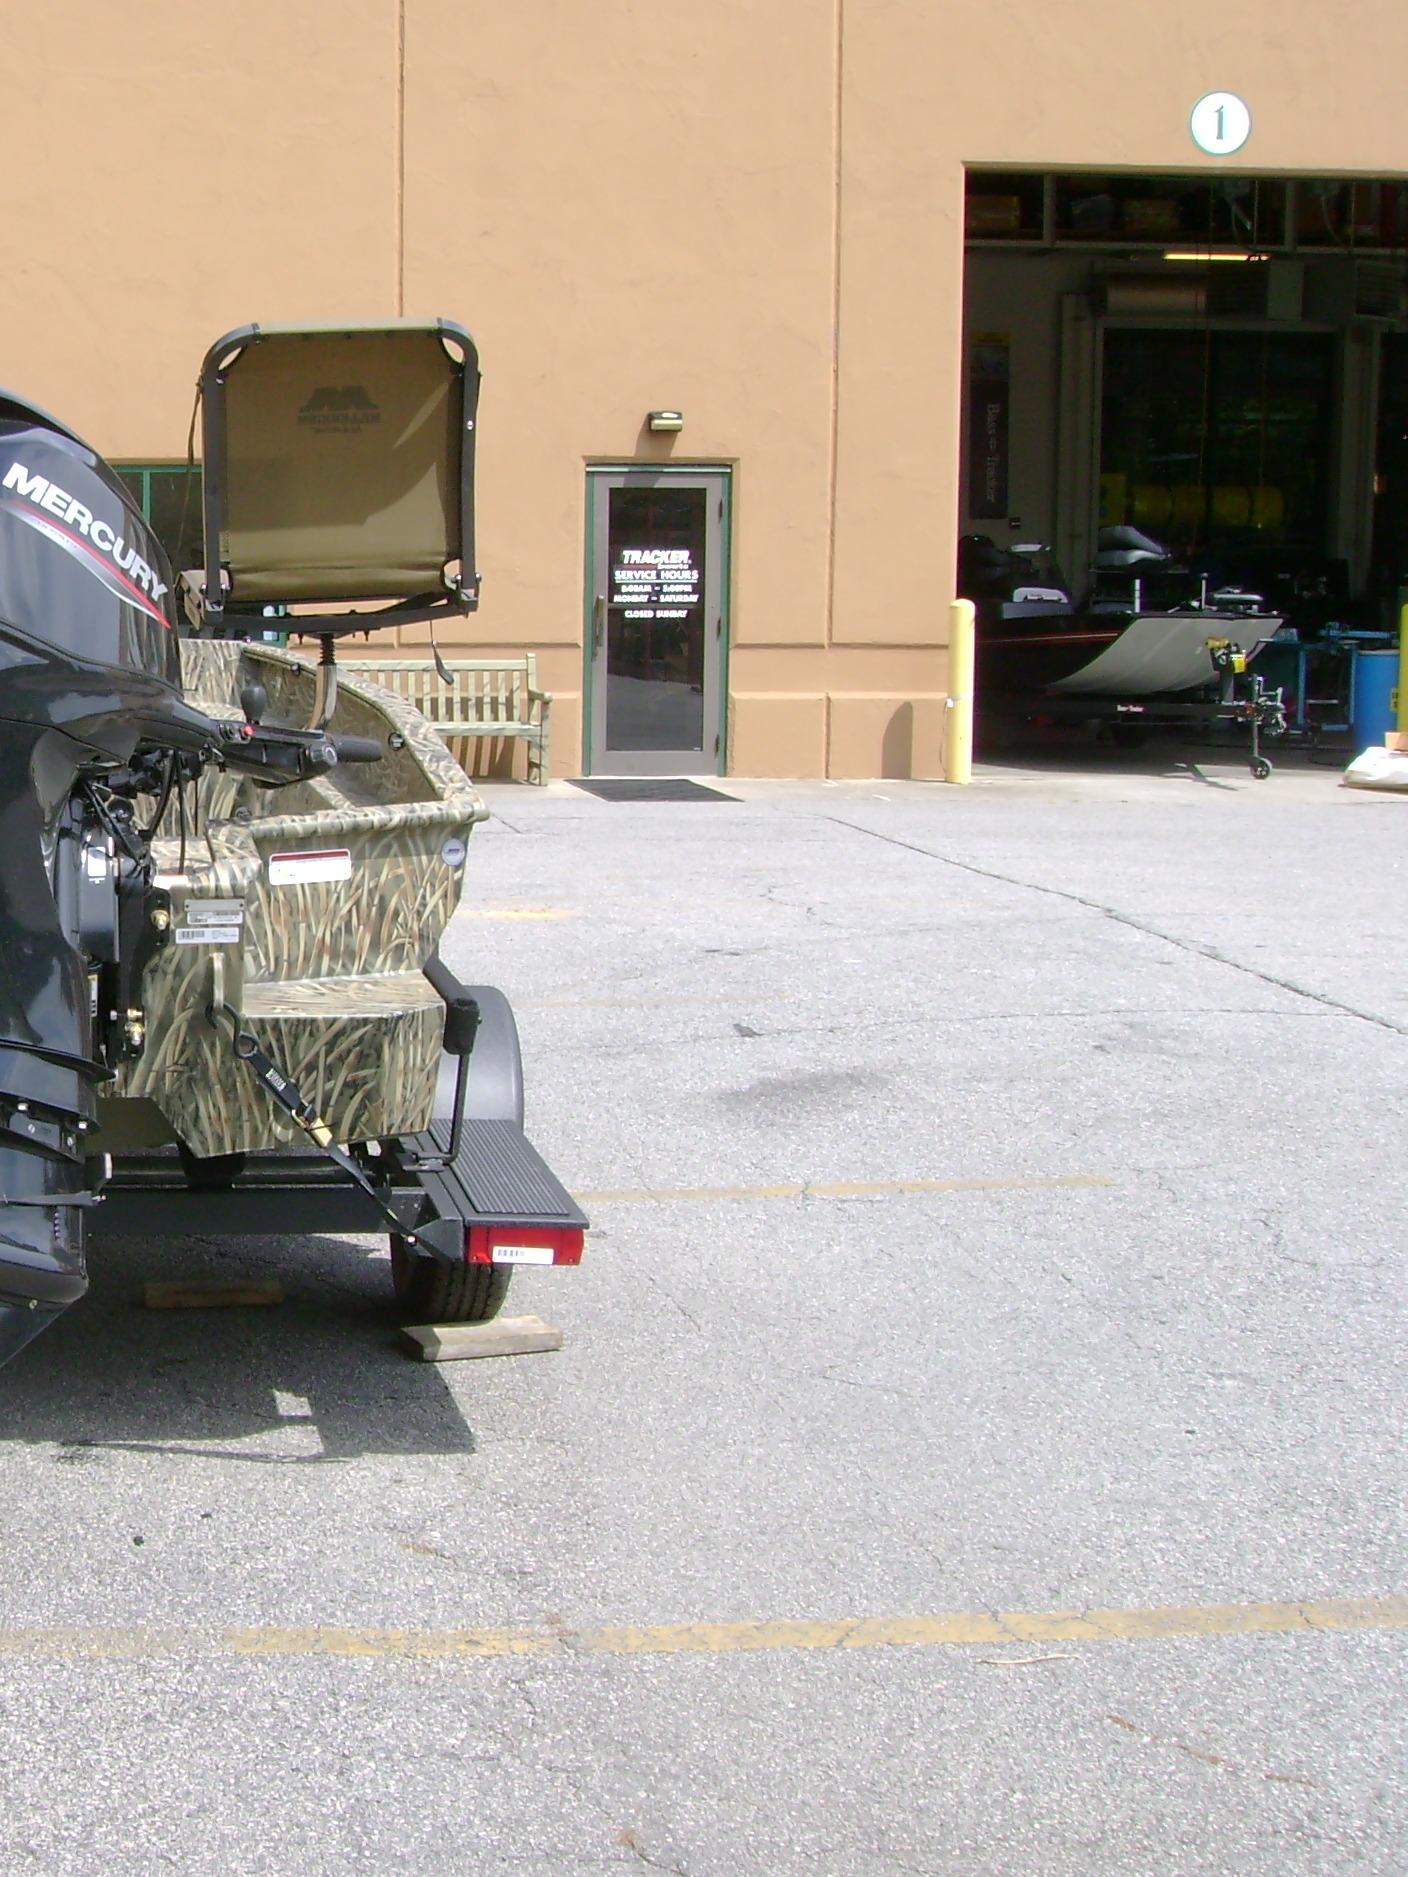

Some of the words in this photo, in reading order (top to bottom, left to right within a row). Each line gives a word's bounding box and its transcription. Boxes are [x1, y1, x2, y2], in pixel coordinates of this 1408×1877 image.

[1214, 104, 1225, 141] 1
[1, 462, 168, 602] MERCURY
[623, 550, 690, 564] TRACKER
[614, 570, 657, 580] SERVICE
[660, 570, 699, 580] HOURS
[613, 594, 649, 602] MONDAY
[660, 594, 699, 602] SATURDAY
[624, 609, 655, 618] CLOSED
[656, 609, 688, 618] SUNDAY
